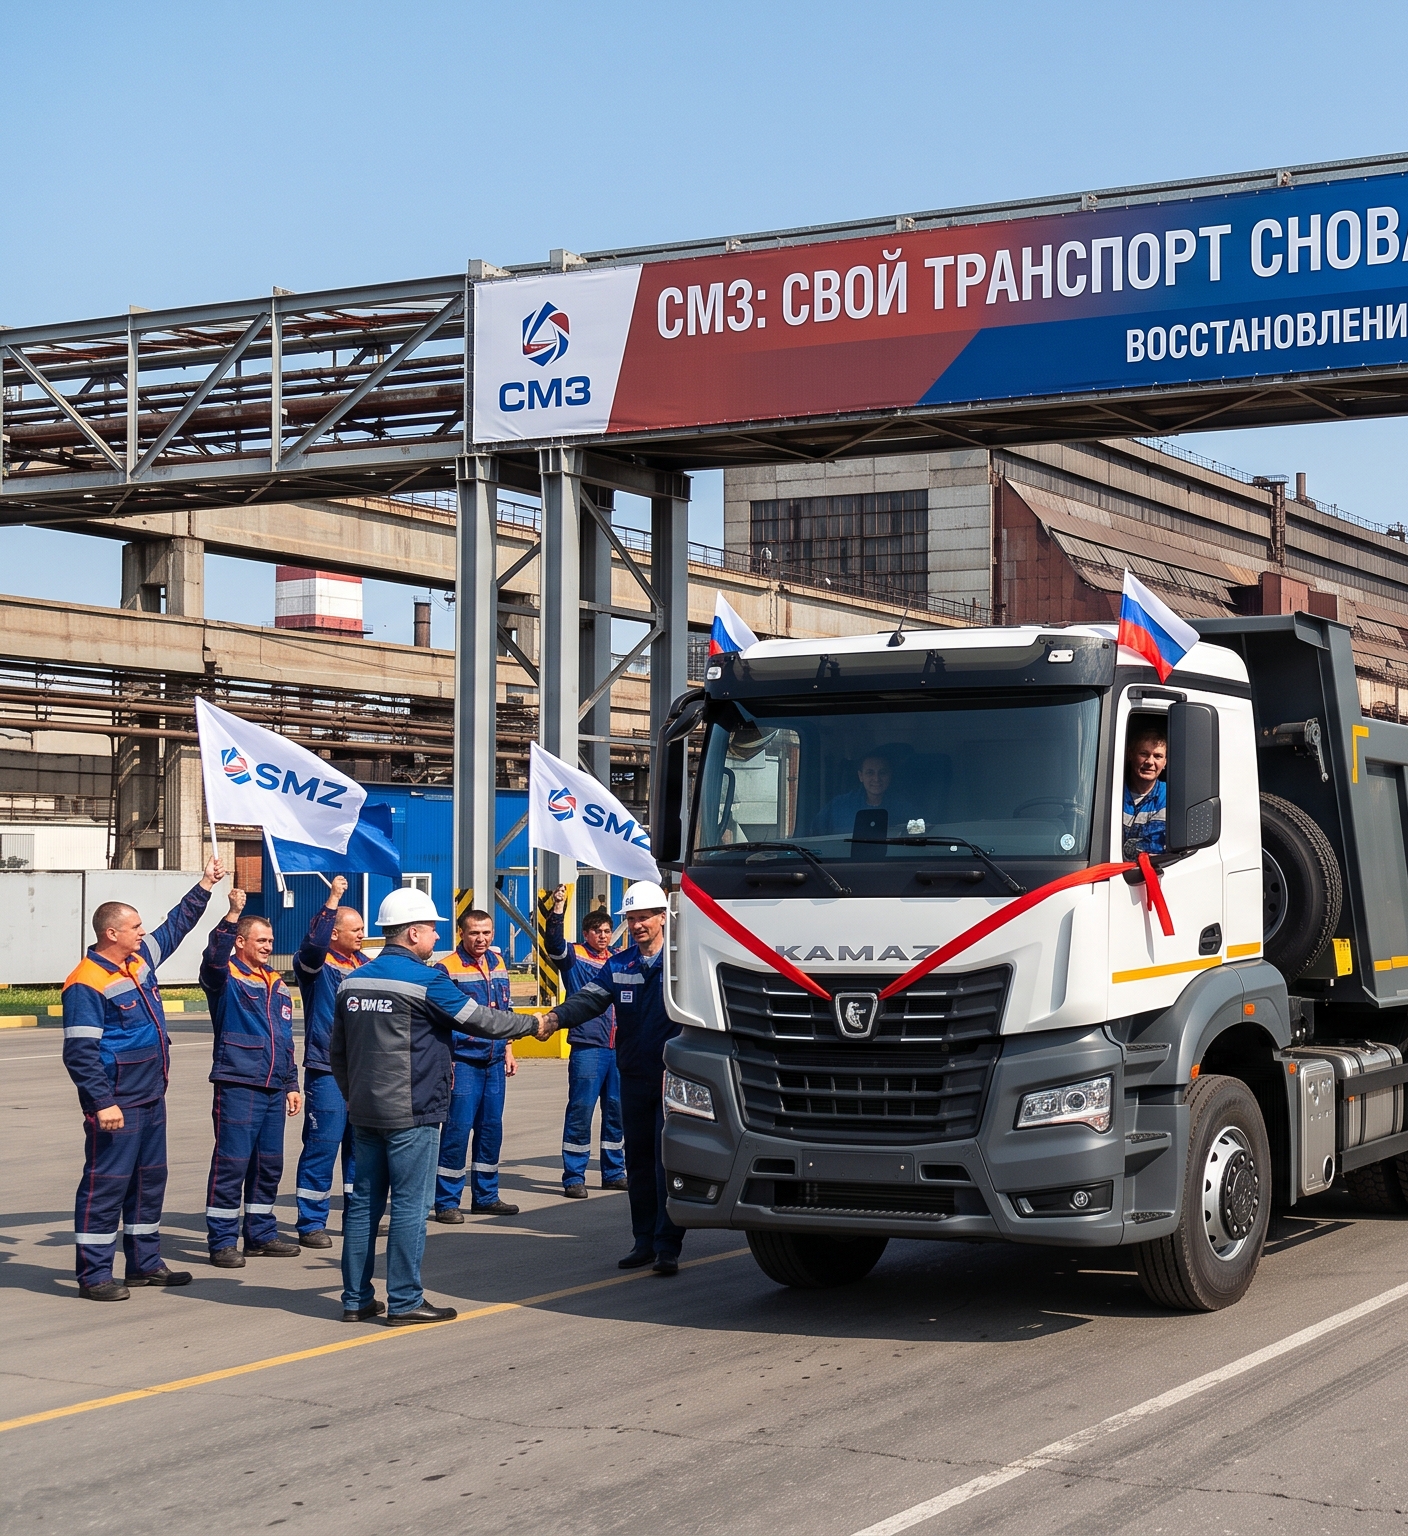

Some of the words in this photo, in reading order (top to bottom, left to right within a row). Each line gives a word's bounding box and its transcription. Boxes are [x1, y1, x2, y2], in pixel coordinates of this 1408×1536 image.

[657, 278, 767, 339] СМЗ:
[782, 246, 908, 326] СВОЙ
[924, 224, 1232, 310] ТРАНСПОРТ
[498, 375, 591, 412] СМЗ
[255, 763, 348, 809] SMZ
[775, 945, 940, 961] KAMAZ
